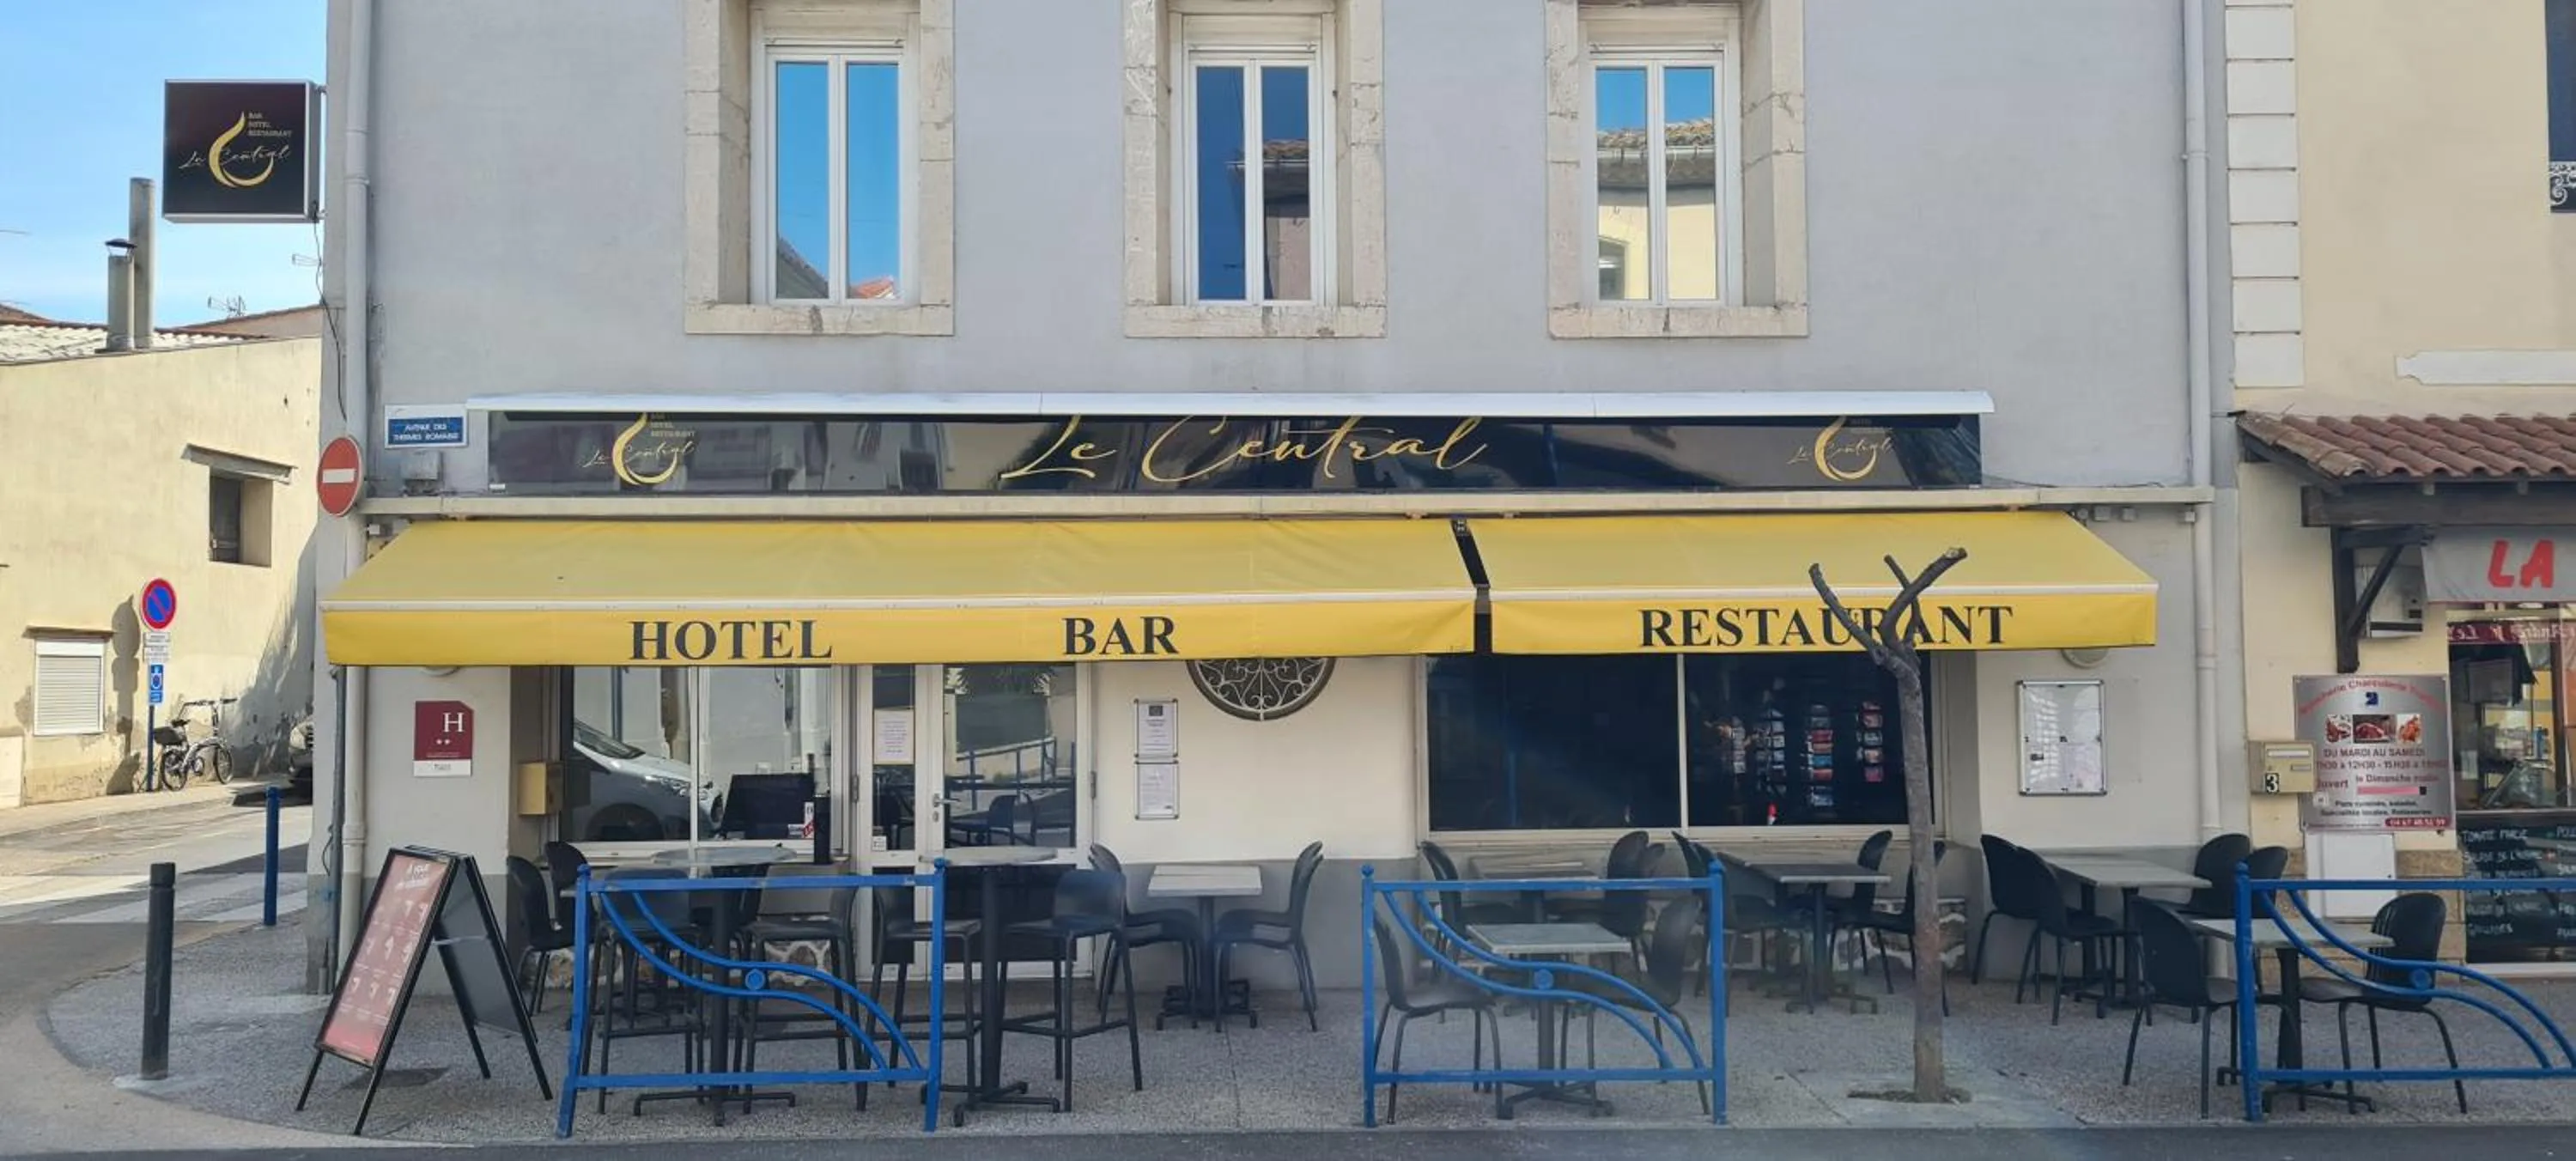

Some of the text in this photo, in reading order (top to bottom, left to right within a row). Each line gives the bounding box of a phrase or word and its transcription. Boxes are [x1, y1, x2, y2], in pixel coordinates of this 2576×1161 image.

[999, 415, 1489, 483] Le Central
[2488, 538, 2555, 589] LA
[629, 619, 834, 661] HOTEL
[1062, 616, 1180, 656] BAR
[443, 712, 465, 732] H
[2340, 748, 2372, 757] MARDI
[2372, 748, 2387, 757] AU
[2388, 748, 2427, 757] SAMEDI
[2266, 773, 2279, 793] 3
